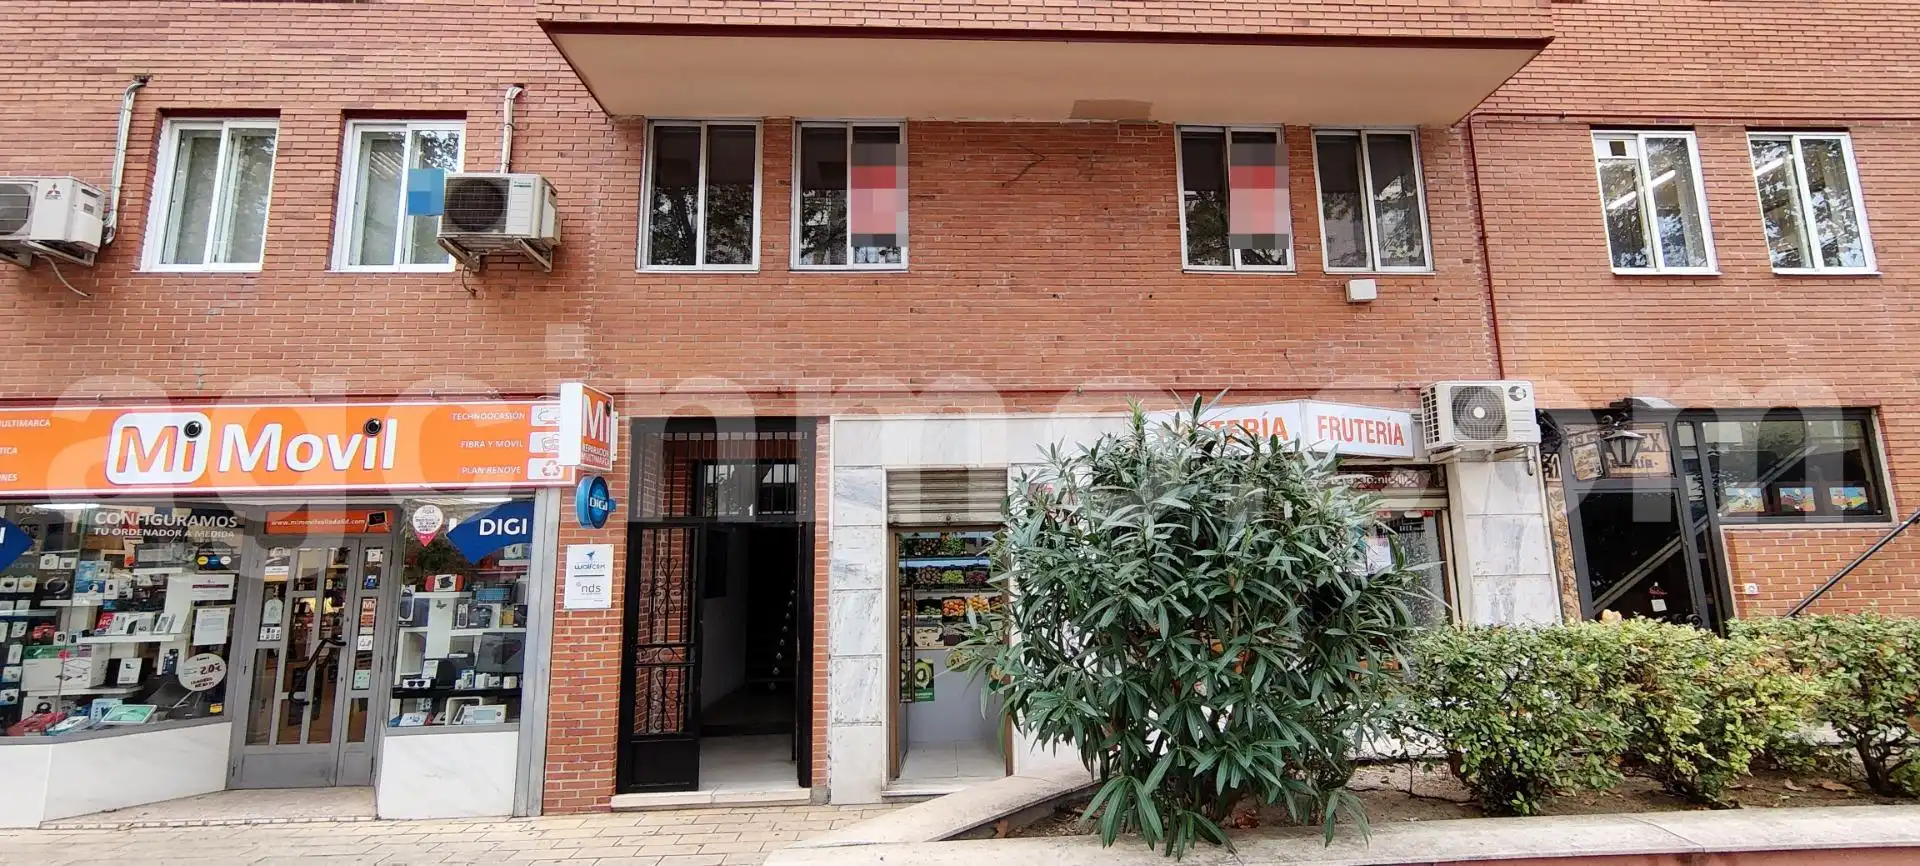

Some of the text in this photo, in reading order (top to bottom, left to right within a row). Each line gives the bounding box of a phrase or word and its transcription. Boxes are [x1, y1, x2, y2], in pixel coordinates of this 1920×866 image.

[582, 393, 612, 444] Mi
[1316, 415, 1405, 446] FRUTERÍA
[115, 418, 398, 473] Mi Movil
[460, 439, 524, 448] FIBRA Y MOVIL
[461, 465, 522, 474] PLAN RENOVE
[94, 511, 238, 528] CONFIGURAMOS
[479, 518, 527, 536] DIGI
[94, 527, 236, 539] TU ORDENADOR A MEDIDA
[580, 583, 602, 593] nds
